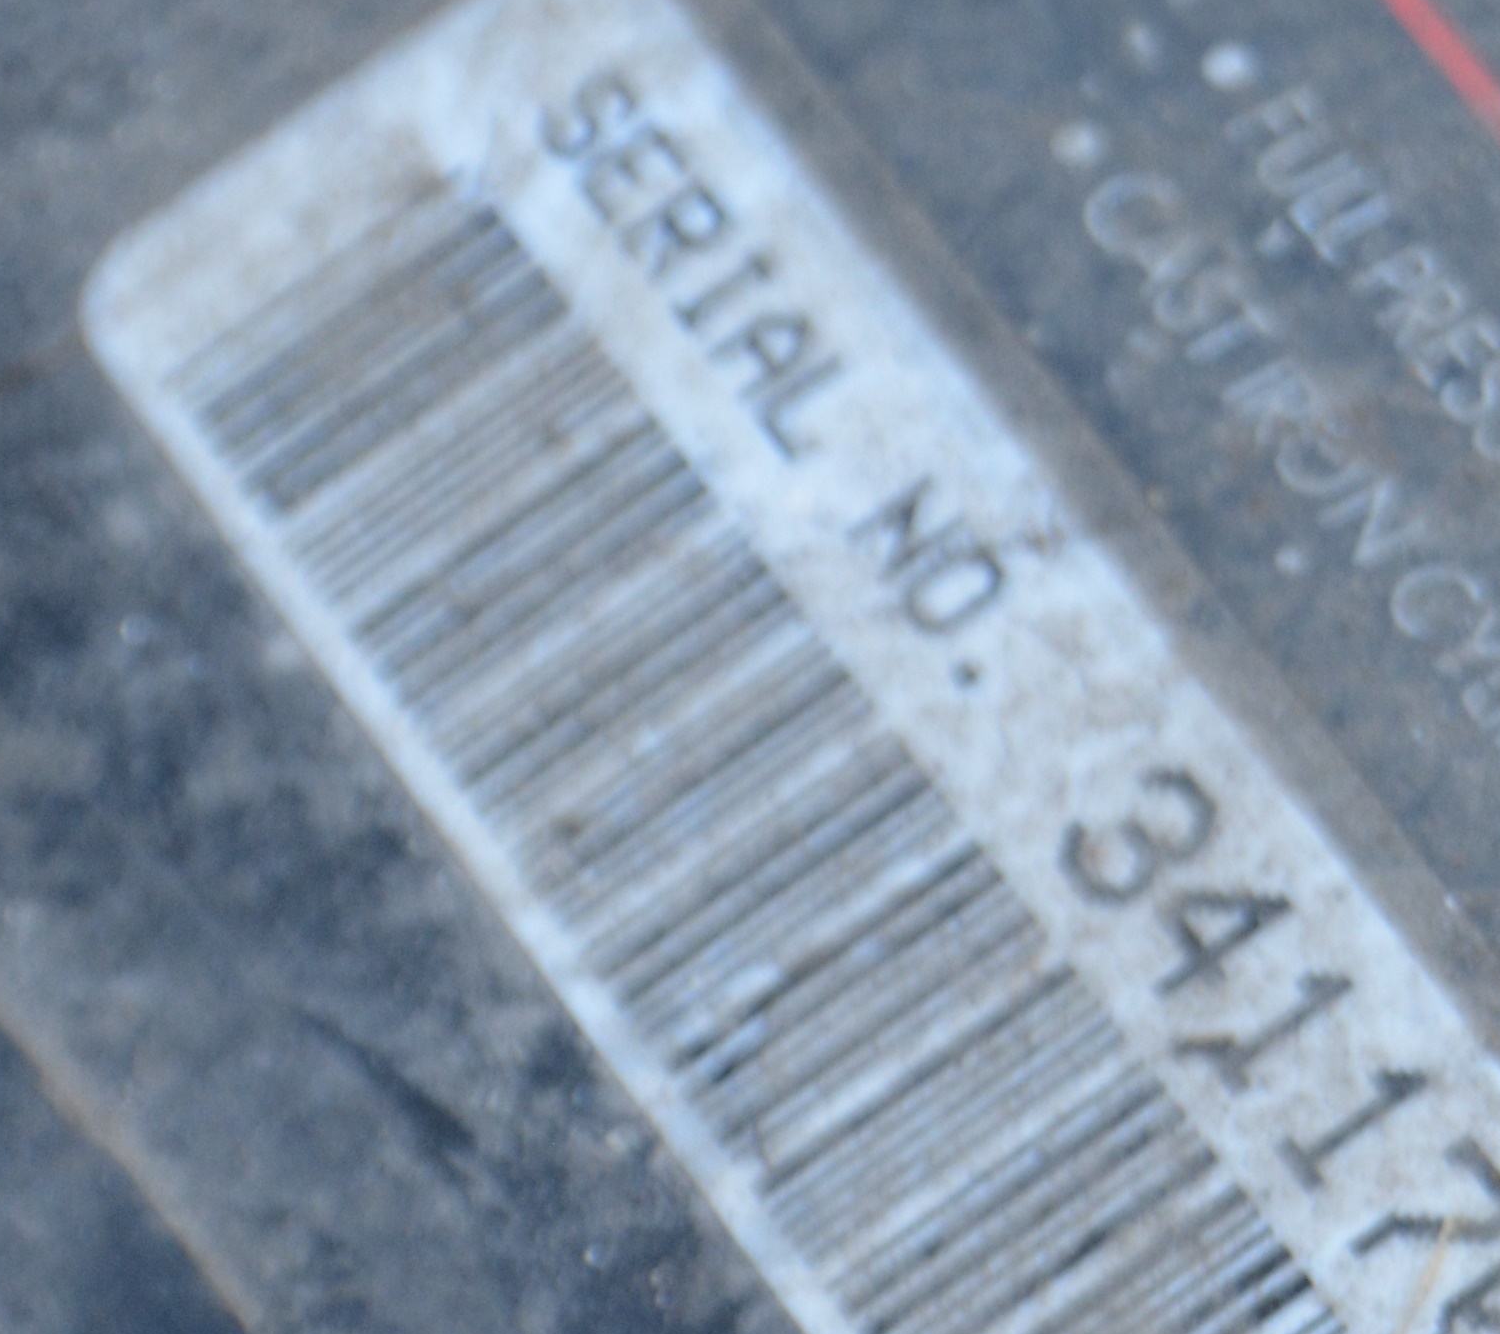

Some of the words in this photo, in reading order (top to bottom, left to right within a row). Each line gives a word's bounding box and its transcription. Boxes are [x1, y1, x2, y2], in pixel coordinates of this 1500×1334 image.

[1220, 84, 1394, 265] FULL
[529, 60, 864, 462] SERIAL
[846, 474, 1016, 699] NO.
[1082, 176, 1275, 363] CAST
[1218, 355, 1428, 571] IRON
